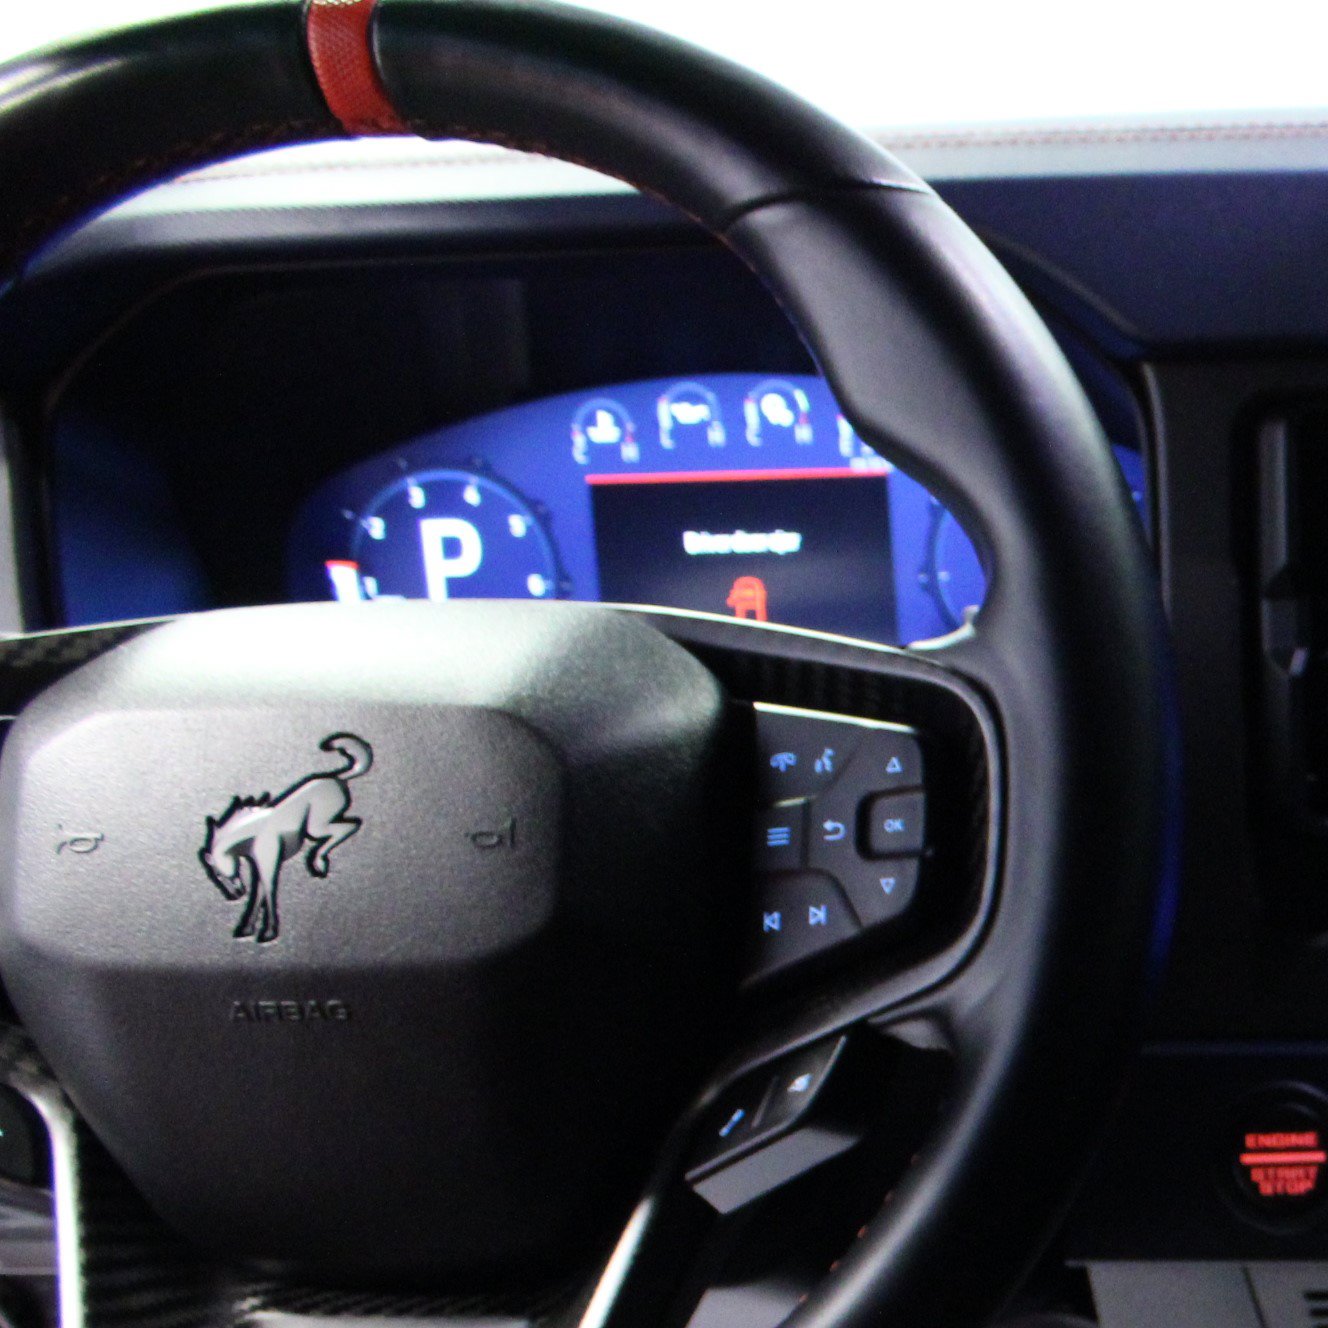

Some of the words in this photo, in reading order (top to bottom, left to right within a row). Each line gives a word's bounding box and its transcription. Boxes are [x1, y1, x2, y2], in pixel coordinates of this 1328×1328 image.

[419, 517, 482, 601] P
[230, 999, 349, 1021] AIRBAG
[1246, 1132, 1318, 1148] ENGINE
